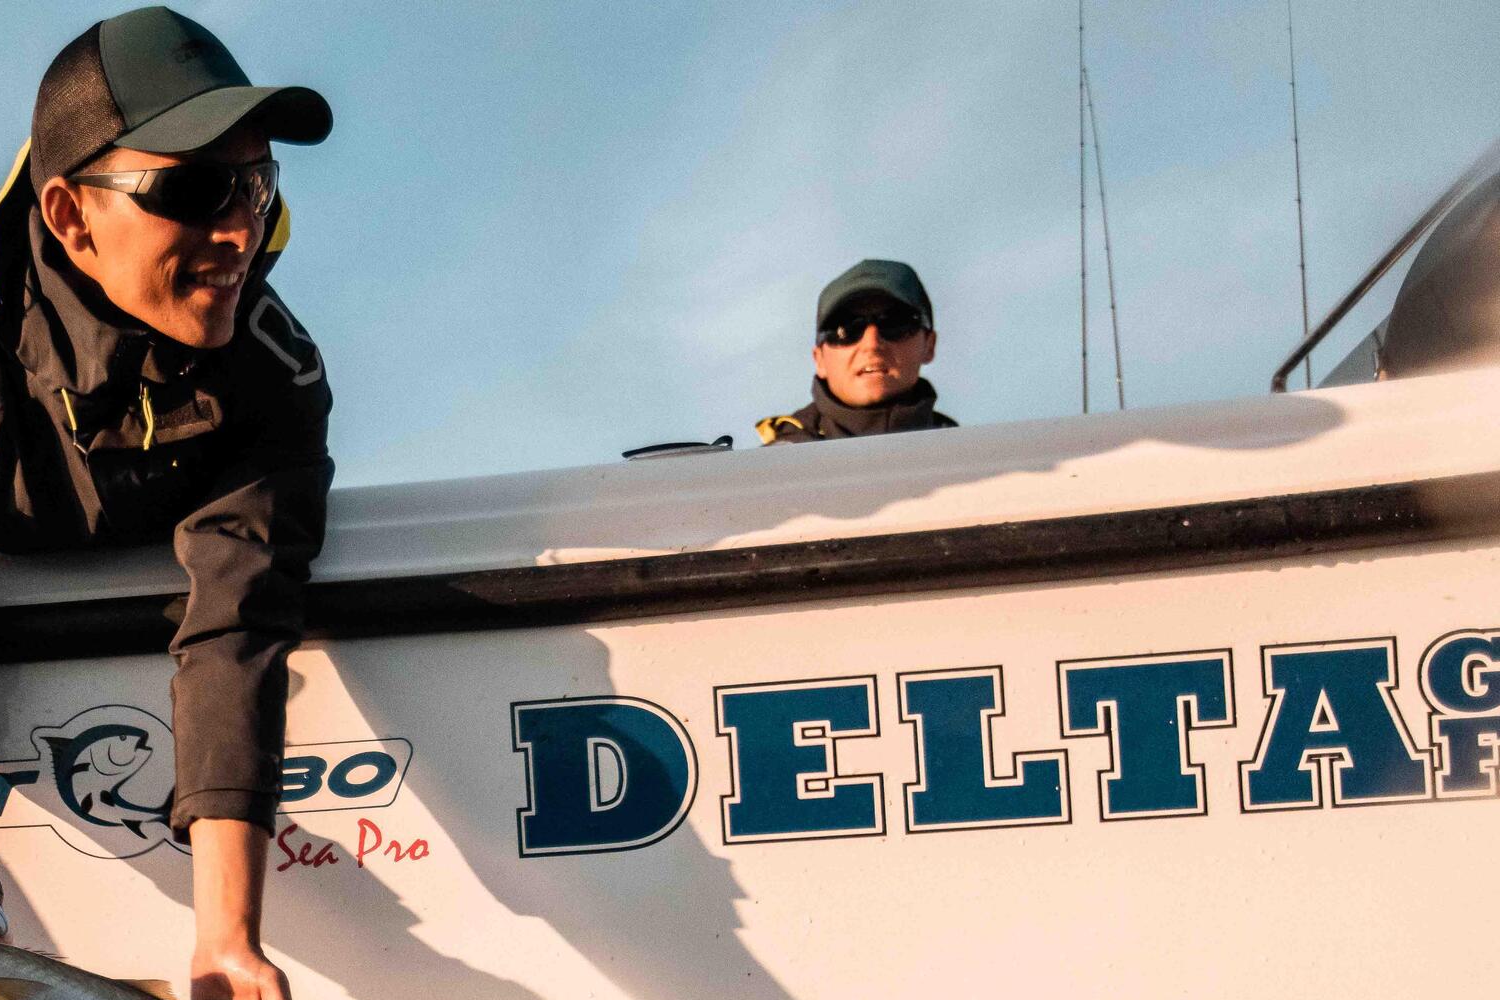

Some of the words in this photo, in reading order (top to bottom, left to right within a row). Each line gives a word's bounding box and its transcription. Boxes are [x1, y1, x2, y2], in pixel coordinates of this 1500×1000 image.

[510, 636, 1436, 858] DELTA
[277, 823, 339, 872] Sea
[356, 818, 430, 868] Pro
